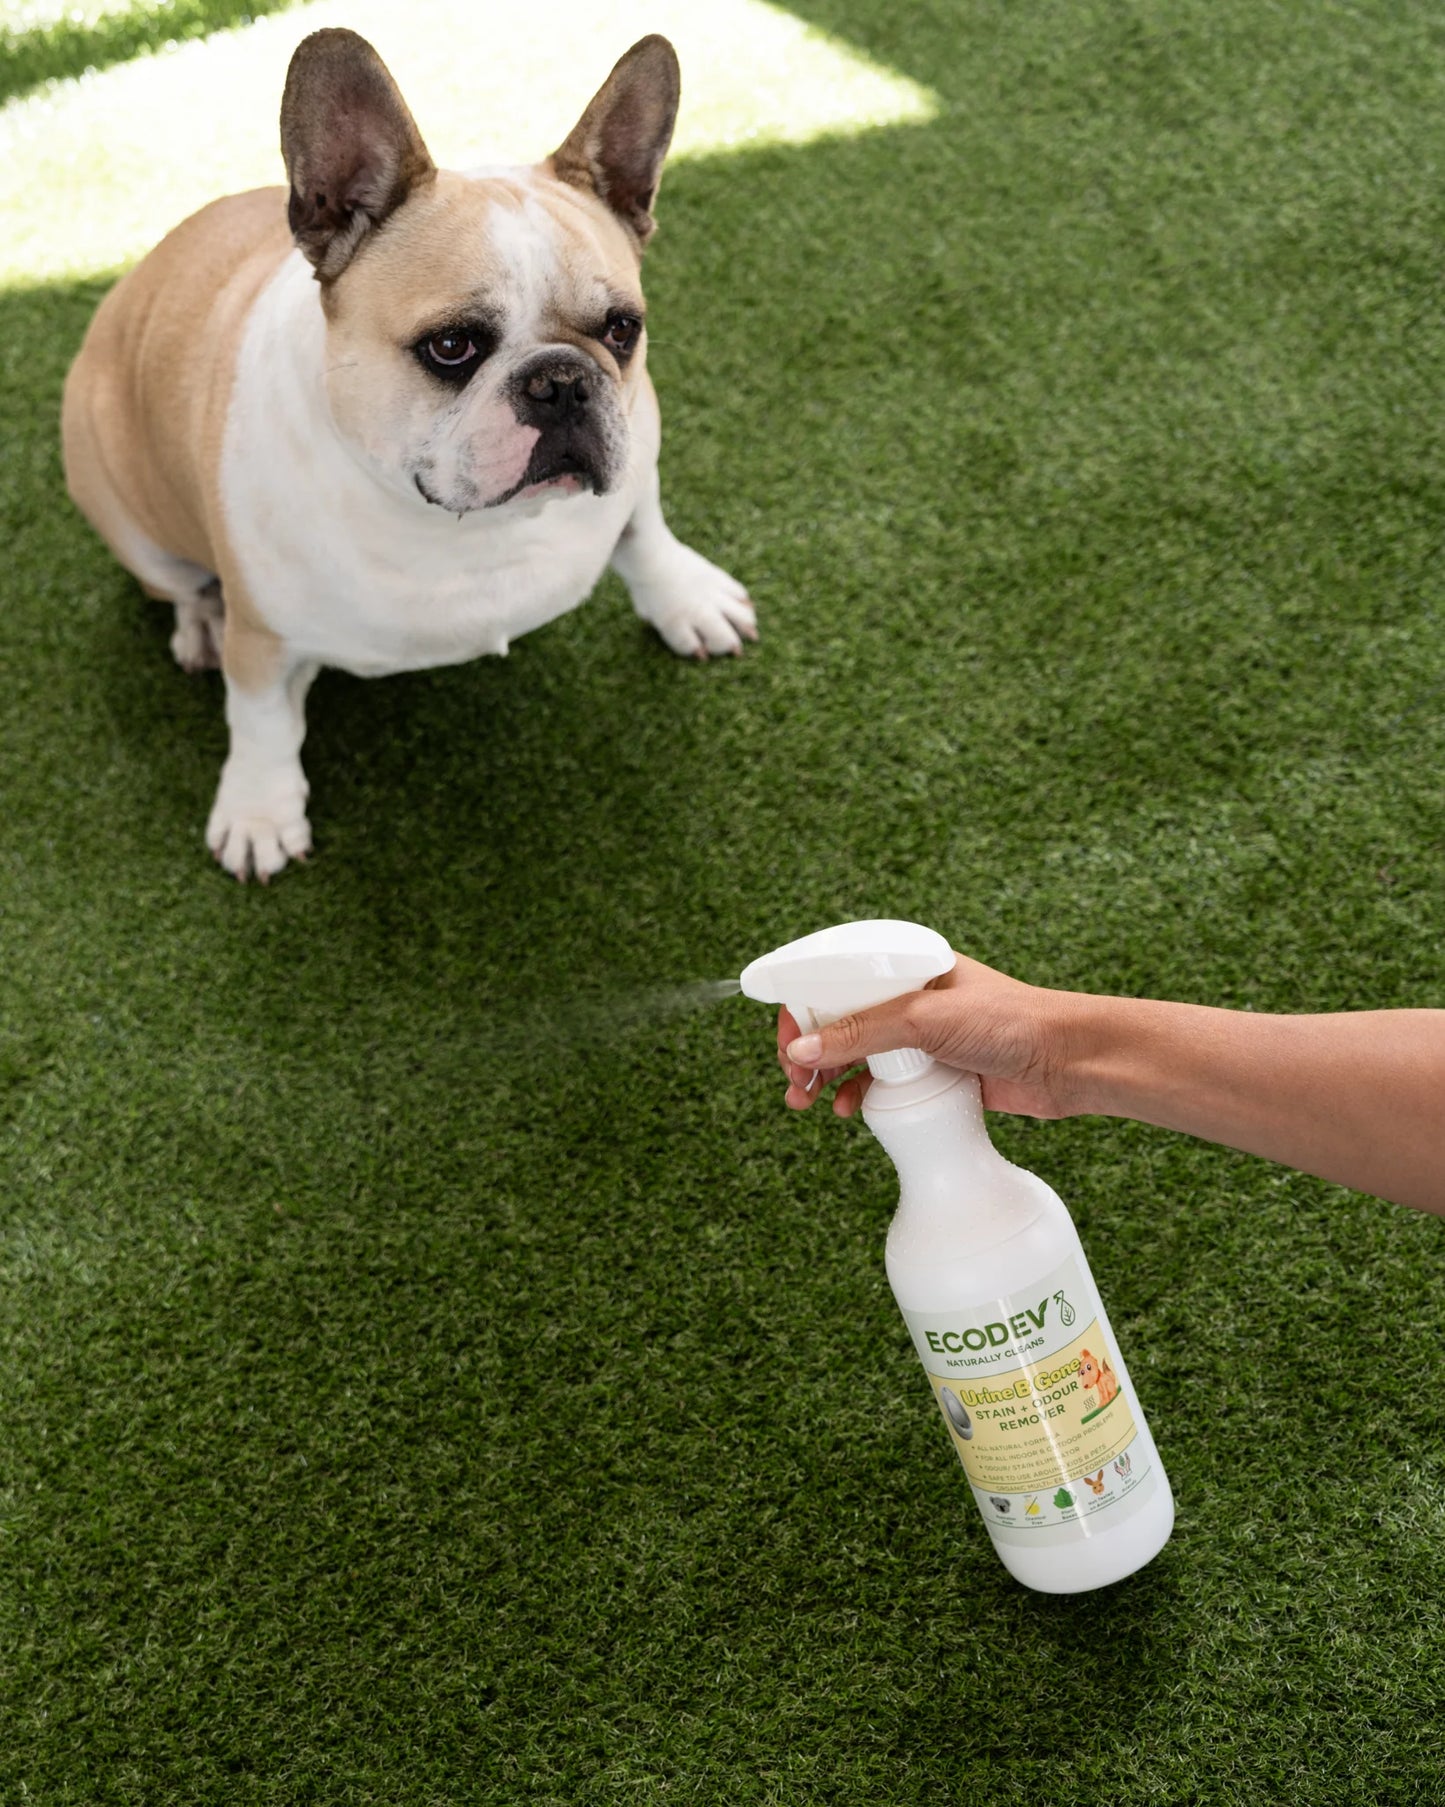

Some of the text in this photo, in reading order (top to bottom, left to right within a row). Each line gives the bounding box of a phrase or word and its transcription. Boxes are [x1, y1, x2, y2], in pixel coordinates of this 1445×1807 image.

[925, 1297, 1049, 1353] ECODEV
[946, 1336, 1045, 1367] NATURALLY CLEANS
[960, 1358, 1081, 1407] Urine B Gone
[975, 1405, 1016, 1420] STAIN
[1032, 1380, 1079, 1408] ODOUR
[999, 1404, 1066, 1431] REMOVER
[1009, 1450, 1038, 1459] INDOOR
[1046, 1434, 1082, 1452] OTDOOR
[1024, 1432, 1060, 1447] FORMA
[1012, 1462, 1034, 1471] STAIN
[1066, 1456, 1083, 1467] KIDS
[1090, 1444, 1106, 1457] PETS
[1085, 1450, 1116, 1471] FORMULA
